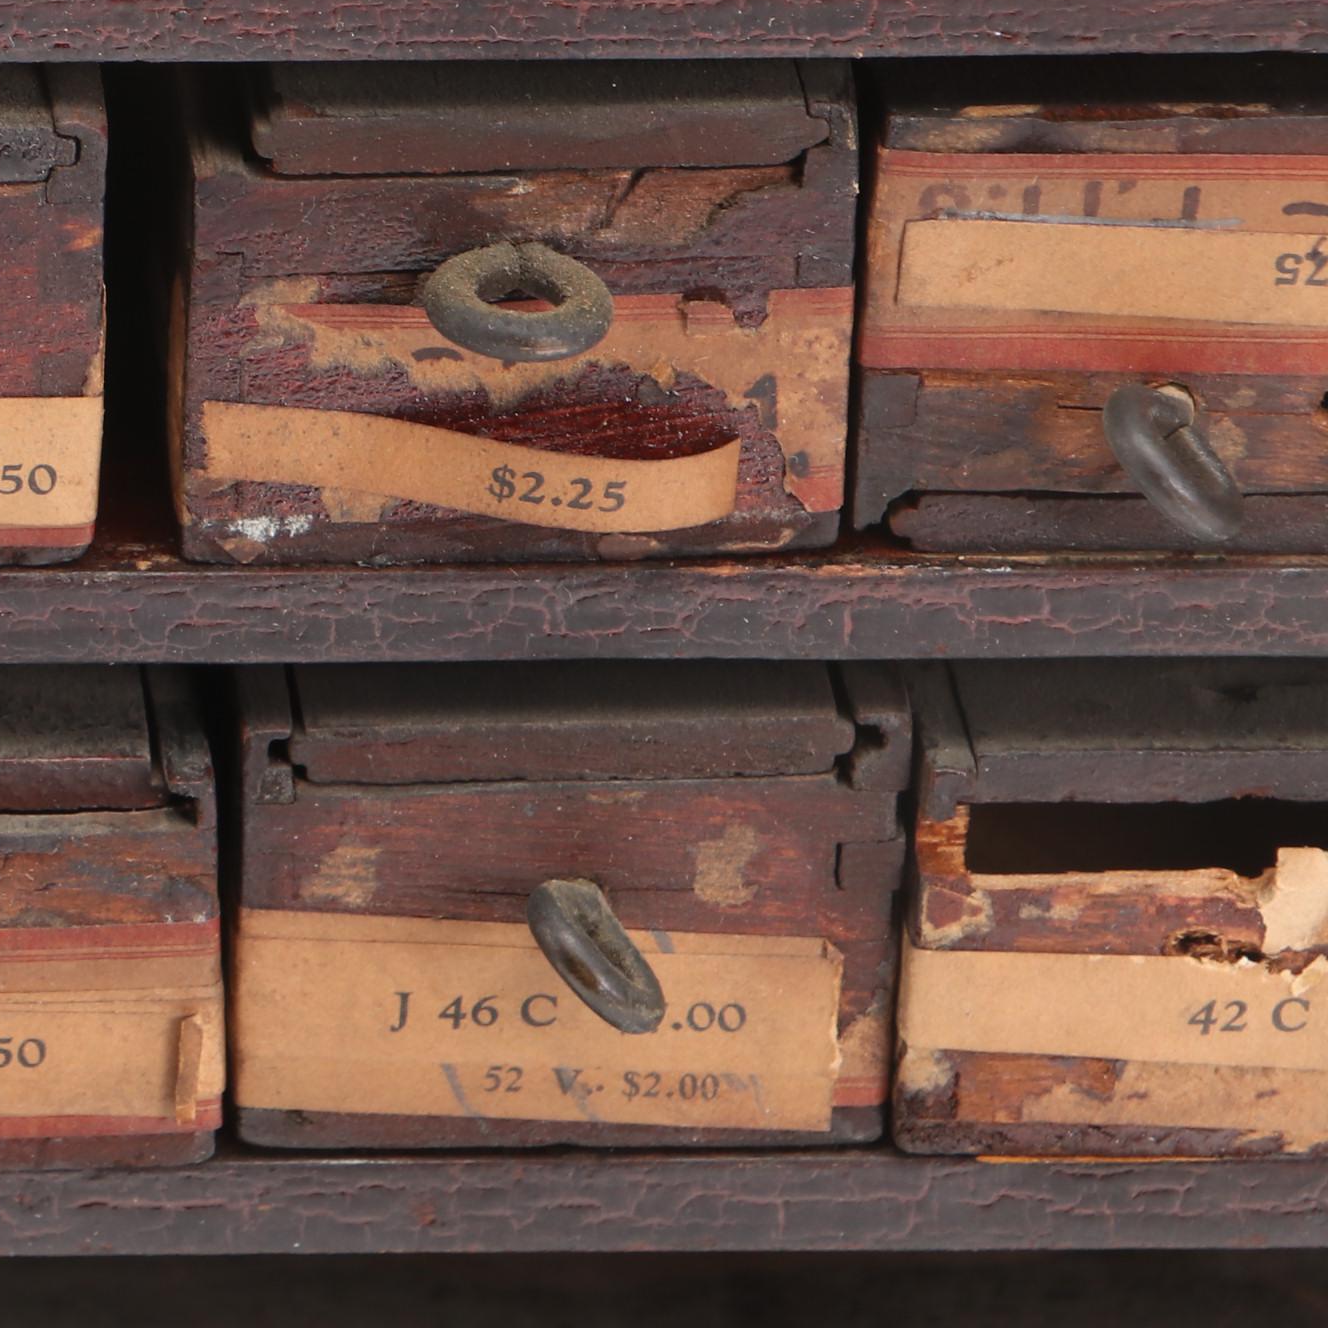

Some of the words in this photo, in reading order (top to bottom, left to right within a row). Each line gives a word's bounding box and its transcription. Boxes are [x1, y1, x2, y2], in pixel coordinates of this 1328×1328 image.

[486, 464, 627, 514] $2.25
[390, 991, 413, 1032] J
[438, 995, 499, 1030] 46
[520, 994, 558, 1027] C
[1188, 998, 1248, 1035] 42
[1271, 997, 1310, 1032] C
[483, 1066, 524, 1093] 52
[621, 1071, 720, 1102] $2.00
